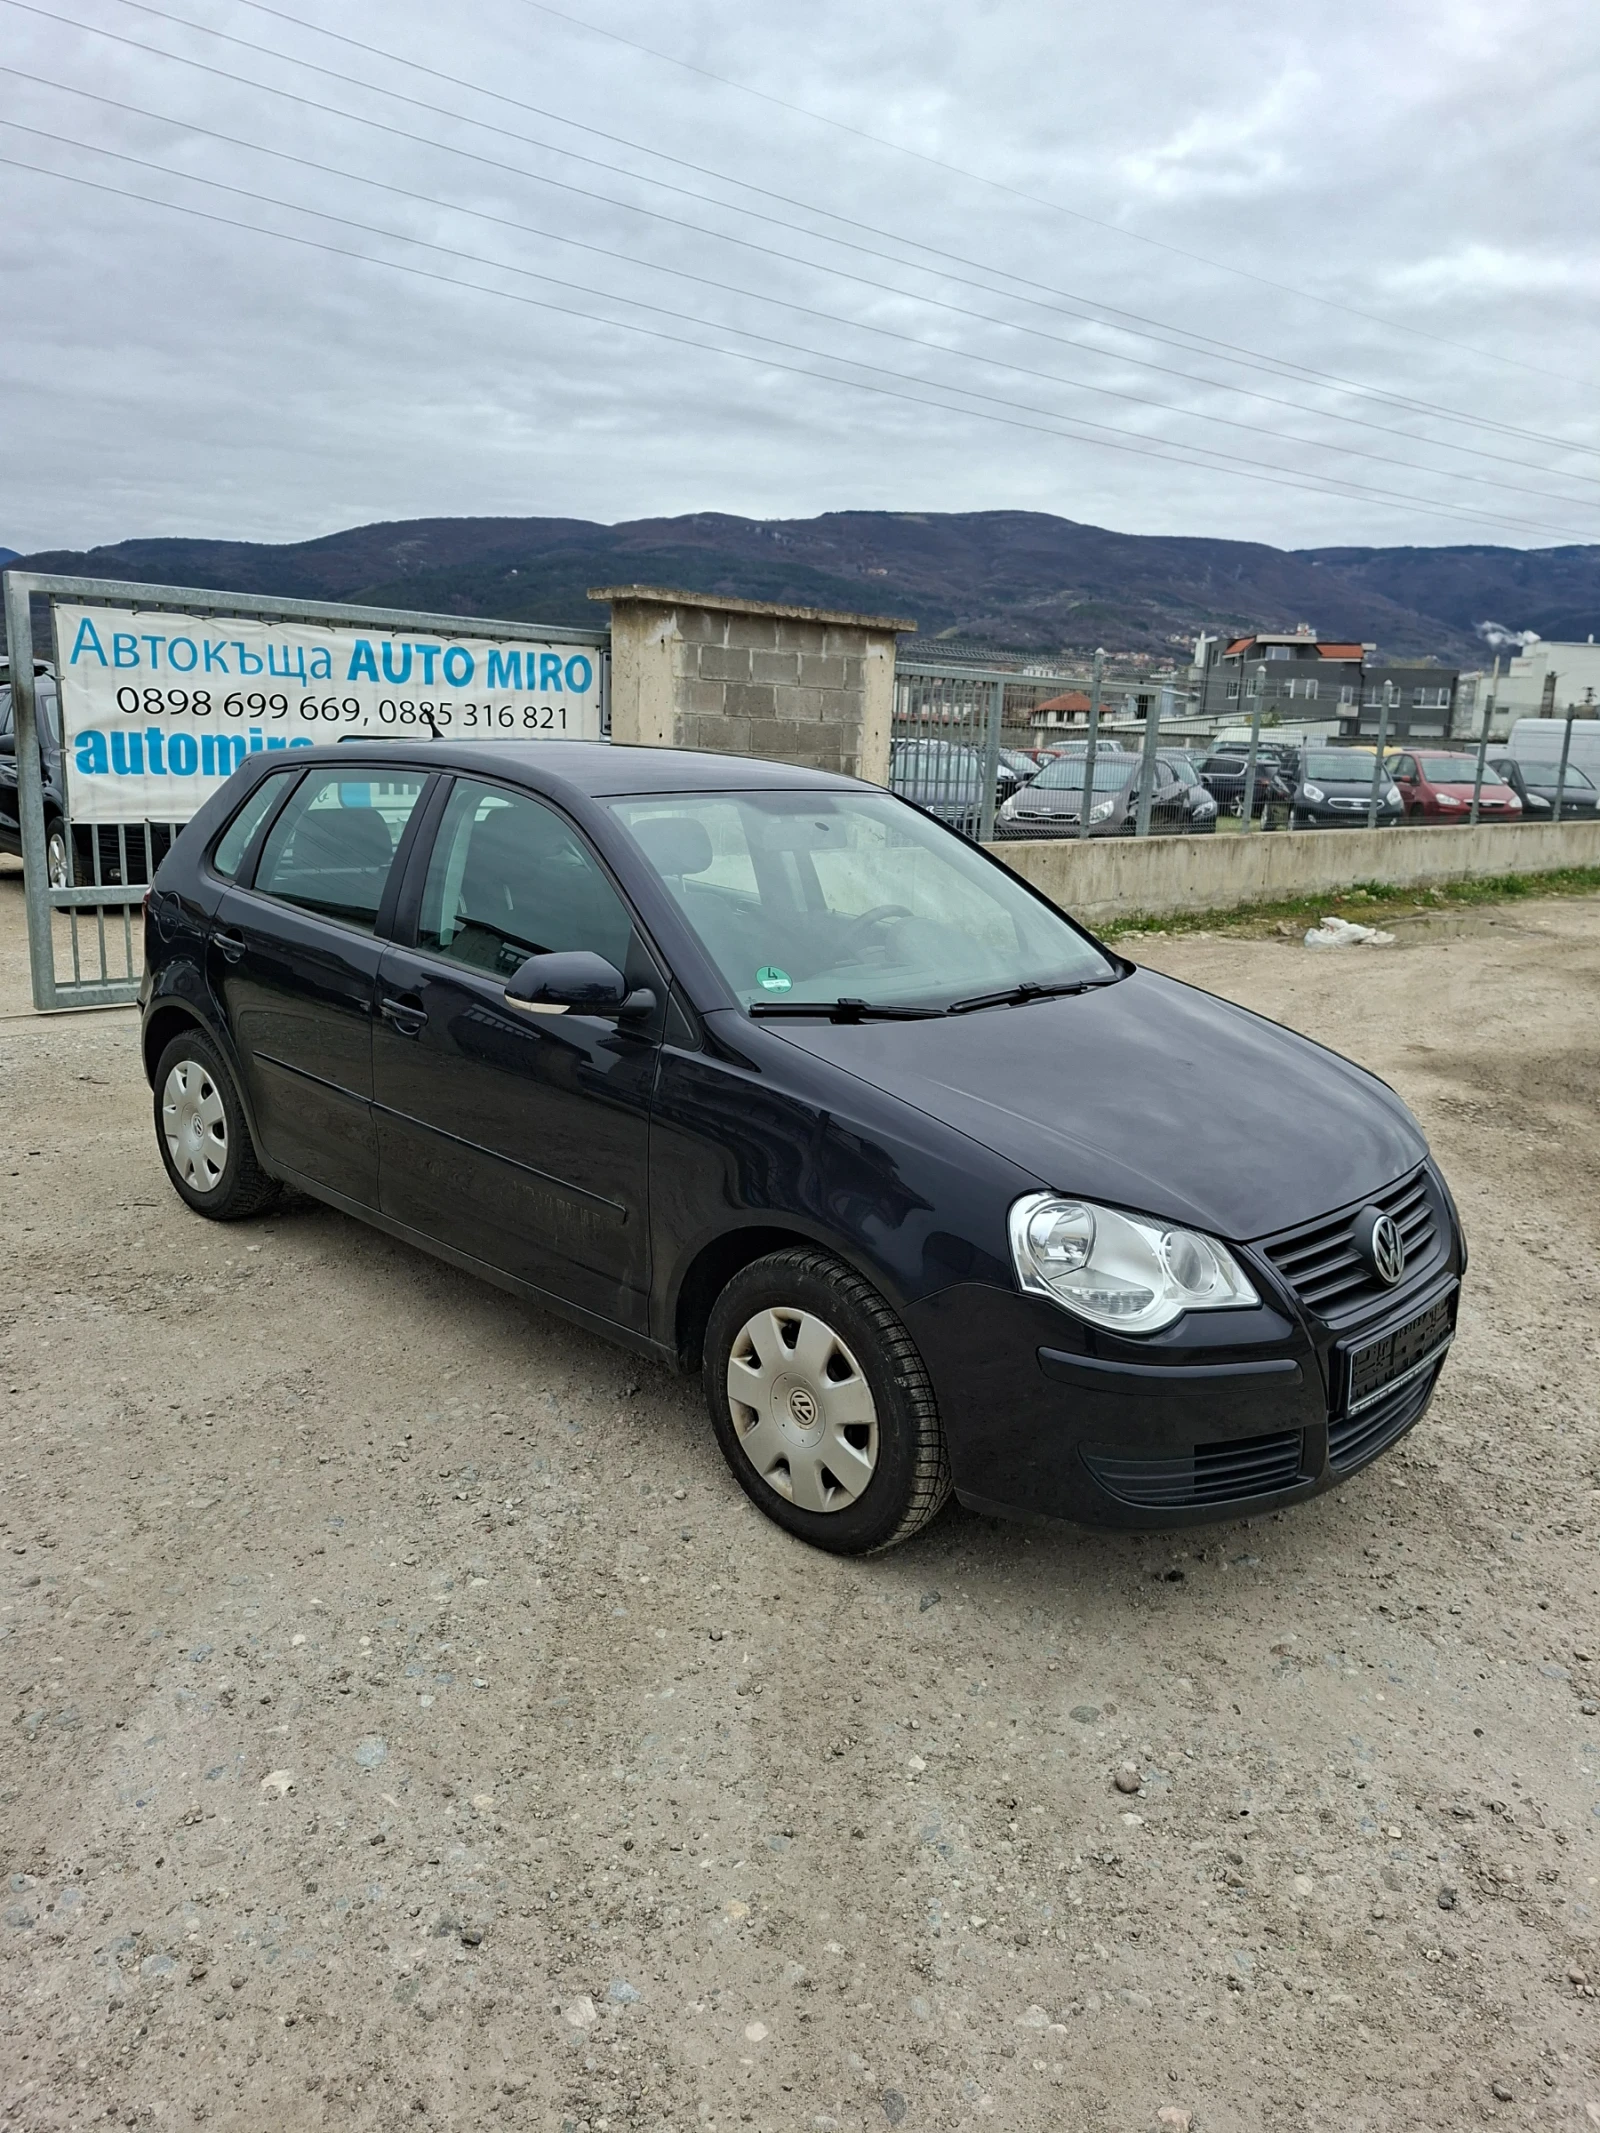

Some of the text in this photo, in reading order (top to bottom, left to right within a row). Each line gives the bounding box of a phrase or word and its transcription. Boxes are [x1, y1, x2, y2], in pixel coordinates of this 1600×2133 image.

[69, 617, 332, 687] Автокъща
[347, 638, 593, 694] AUTO MIRO
[116, 686, 567, 729] 0898 699 669, 0885 316 821
[74, 727, 314, 776] autom
